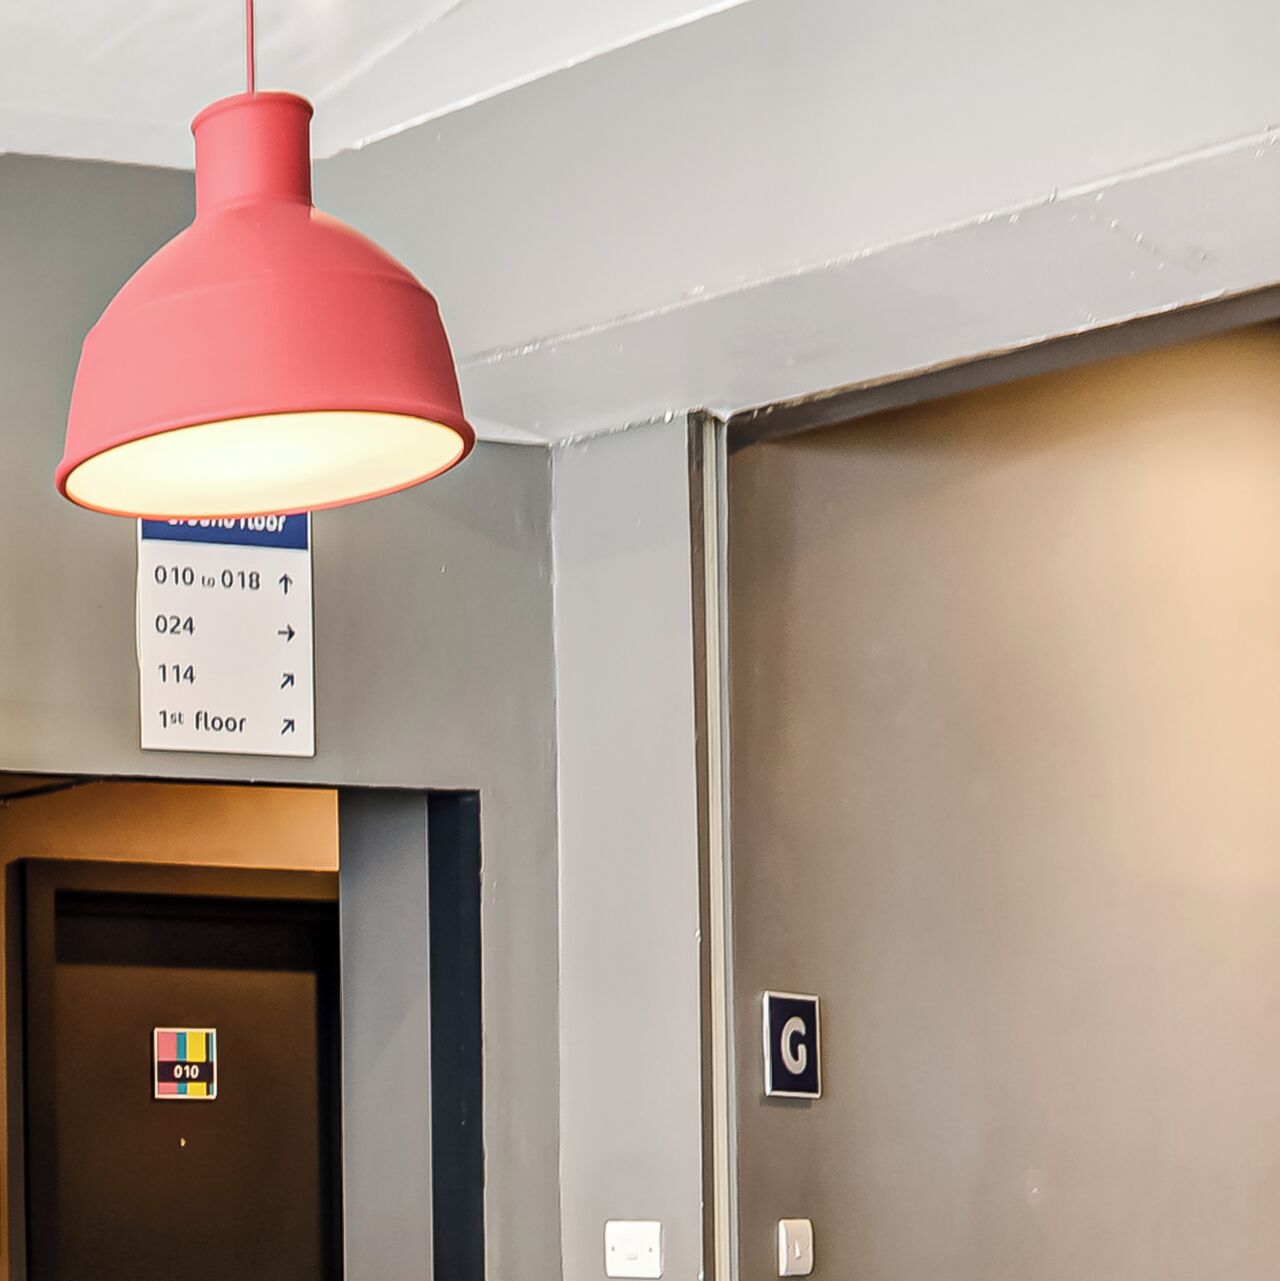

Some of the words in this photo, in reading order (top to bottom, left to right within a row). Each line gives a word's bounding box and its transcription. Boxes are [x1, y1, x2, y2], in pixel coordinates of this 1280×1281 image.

[154, 565, 195, 586] 010
[202, 575, 215, 588] to
[221, 569, 260, 590] 018
[155, 614, 194, 635] 024
[158, 664, 196, 684] 114
[159, 709, 184, 729] 1st
[194, 710, 247, 732] floor
[780, 1016, 807, 1075] G
[173, 1064, 200, 1079] 010
